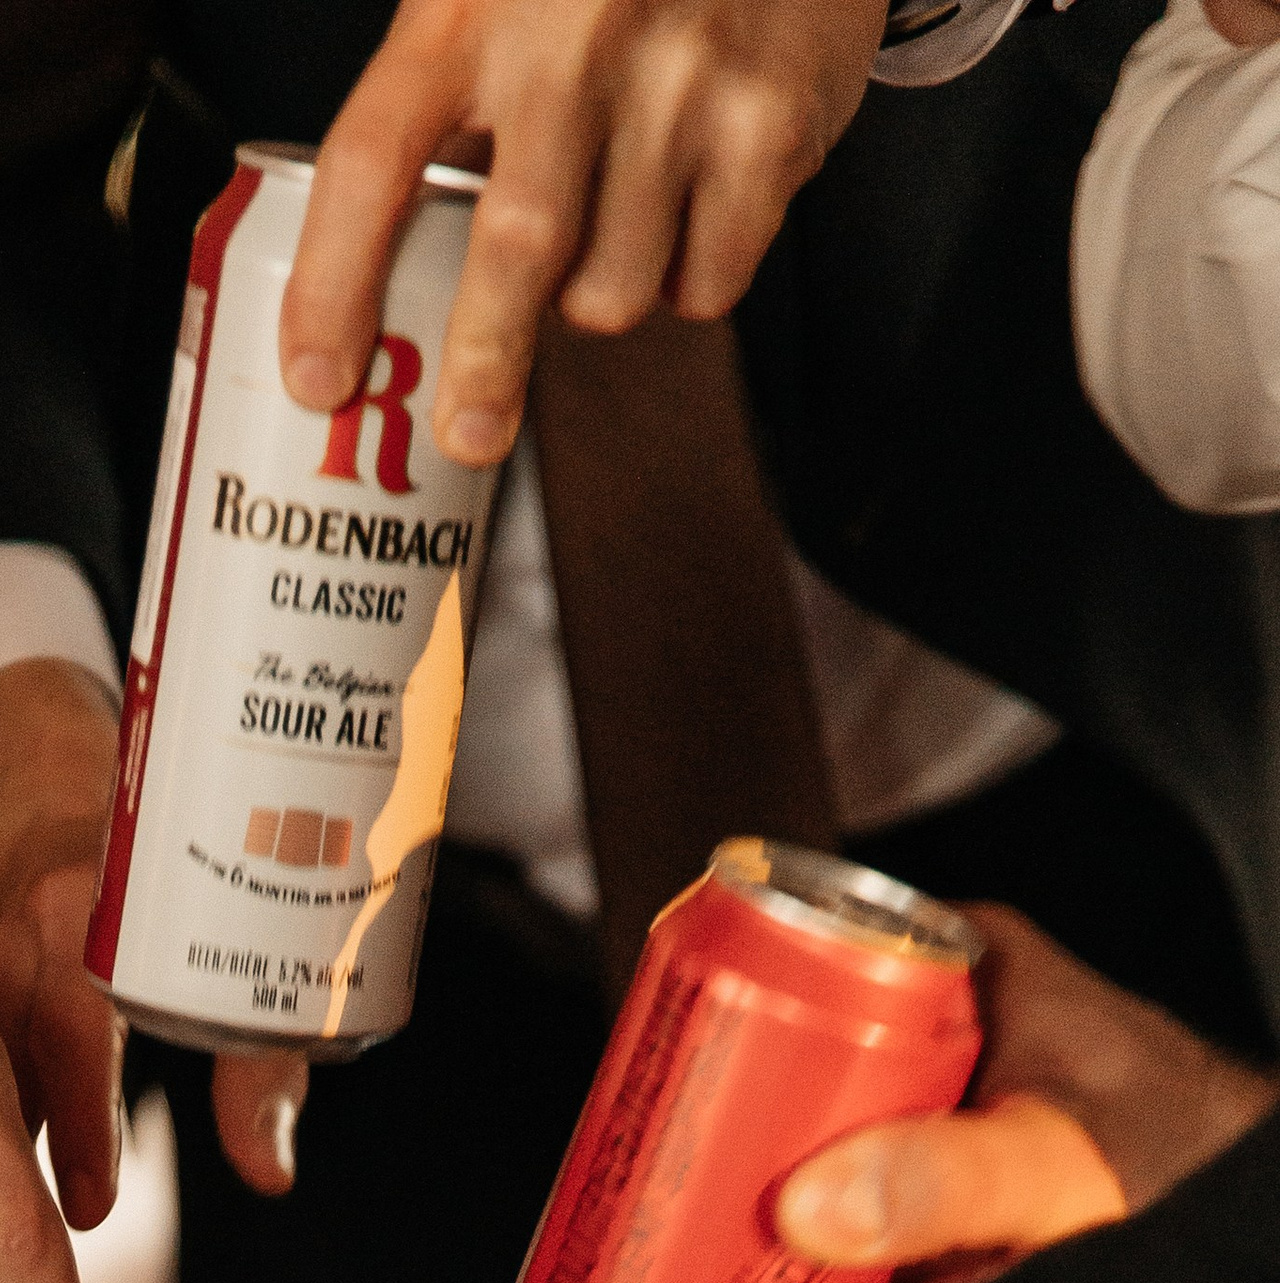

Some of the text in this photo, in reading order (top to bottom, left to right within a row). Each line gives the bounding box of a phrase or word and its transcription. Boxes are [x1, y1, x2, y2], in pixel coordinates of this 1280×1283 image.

[213, 472, 473, 567] RODENBACH
[271, 569, 408, 626] CLASSIC
[239, 689, 394, 750] SOUR ALE
